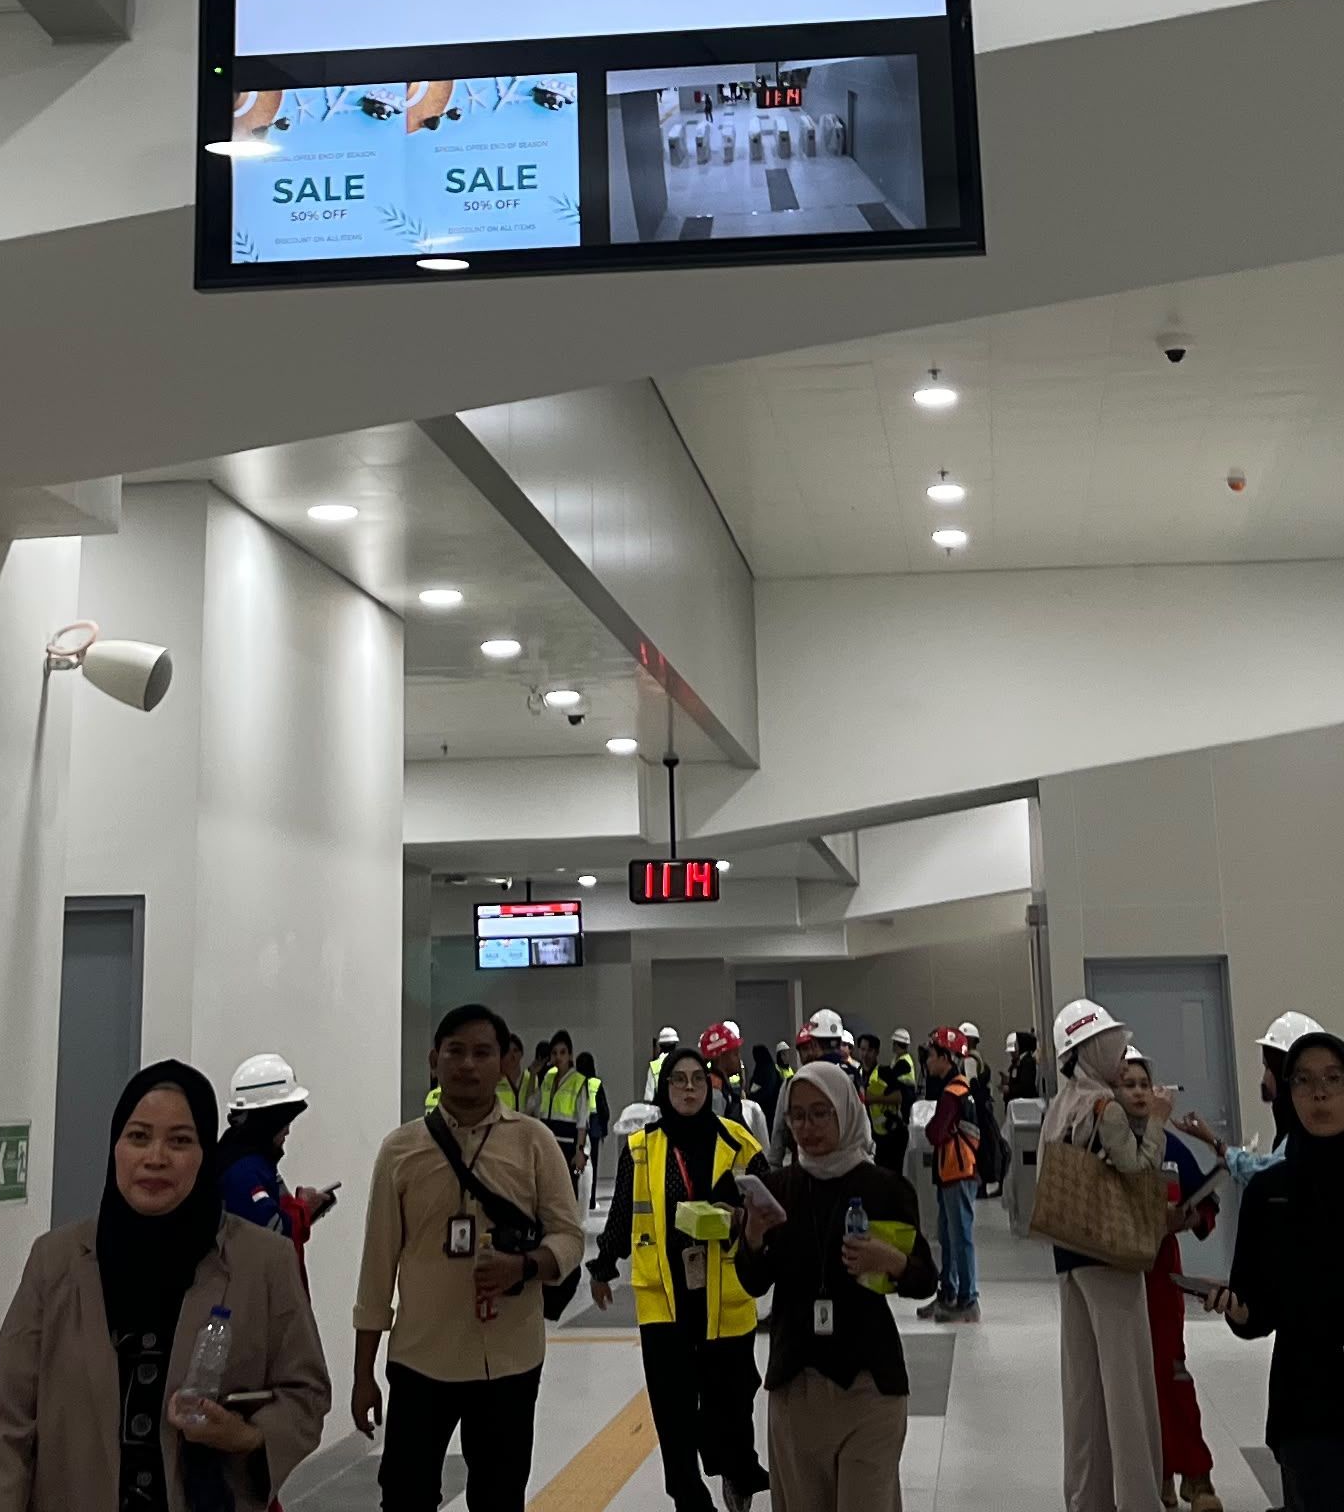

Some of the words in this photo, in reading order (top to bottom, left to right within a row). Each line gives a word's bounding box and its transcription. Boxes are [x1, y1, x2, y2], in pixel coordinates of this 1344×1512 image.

[272, 174, 365, 204] SALE
[445, 164, 538, 194] SALE
[290, 210, 320, 222] 50%
[322, 209, 349, 221] OFF
[463, 200, 492, 212] 50%
[495, 199, 521, 210] OFF
